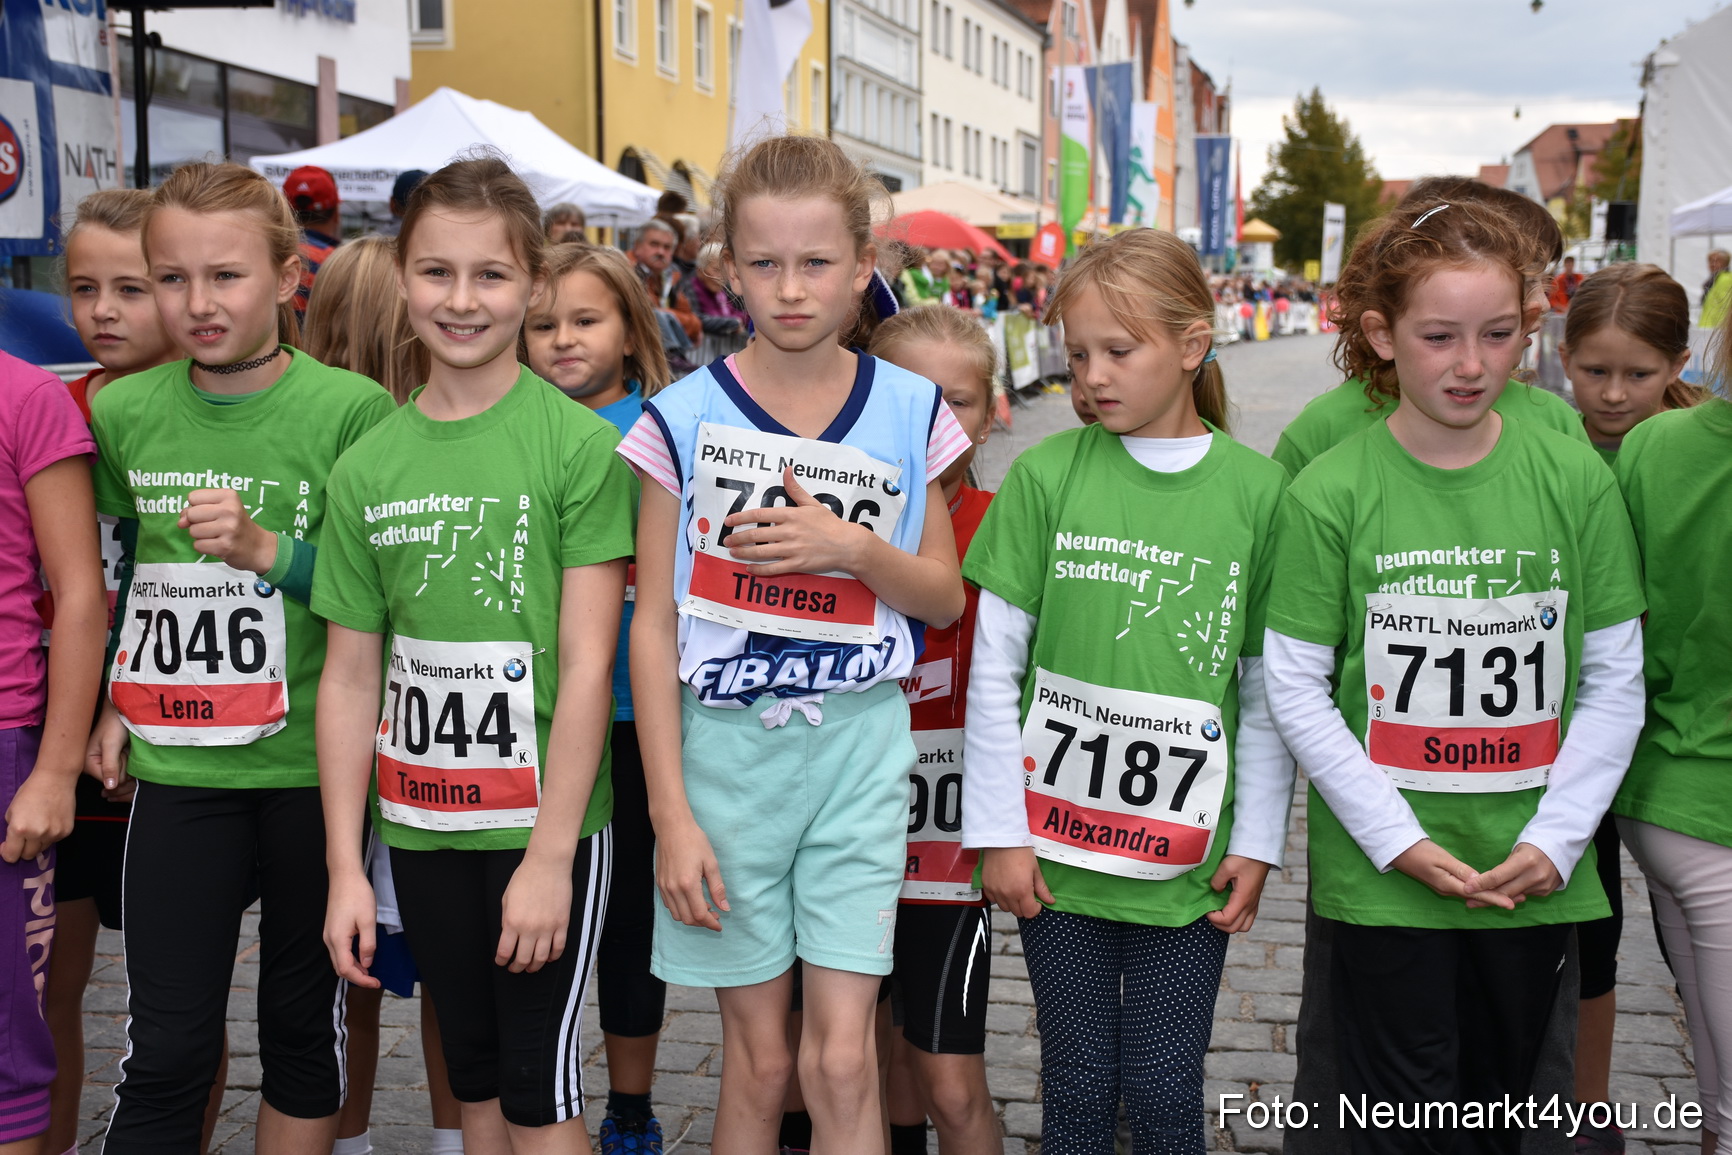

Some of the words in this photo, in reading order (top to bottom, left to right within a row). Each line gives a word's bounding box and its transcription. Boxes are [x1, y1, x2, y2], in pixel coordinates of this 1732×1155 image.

[700, 444, 772, 472] PARTL
[778, 456, 876, 489] Neumarkt
[128, 469, 253, 491] Neumarkter
[369, 519, 445, 546] adtlauf
[700, 538, 706, 550] 5
[510, 494, 530, 613] BAMBINI
[1056, 532, 1184, 566] Neumarkter
[131, 582, 159, 598] PARTL
[161, 581, 245, 598] Neumarkt
[1055, 560, 1152, 593] Stadtlauf
[732, 572, 837, 614] Theresa
[1209, 561, 1240, 677] BAMBINI
[1370, 613, 1442, 634] PARTL
[1447, 614, 1537, 637] Neumarkt
[130, 607, 267, 675] 7046
[116, 667, 122, 681] 5
[269, 667, 277, 679] K
[411, 657, 494, 680] Neumarkt
[1387, 640, 1545, 718] 7131
[159, 694, 214, 720] Lena
[388, 680, 518, 758] 7044
[1038, 687, 1092, 719] PARTL
[1095, 705, 1192, 735] Neumarkt
[1375, 706, 1382, 718] 5
[1551, 703, 1557, 715] K
[379, 739, 384, 750] 5
[519, 752, 527, 763] K
[918, 748, 954, 764] arkt
[1424, 736, 1520, 770] Sophia
[1043, 718, 1208, 812] 7187
[397, 771, 481, 804] Tamina
[1024, 775, 1031, 786] 5
[1198, 812, 1206, 824] K
[1043, 806, 1170, 857] Alexandra
